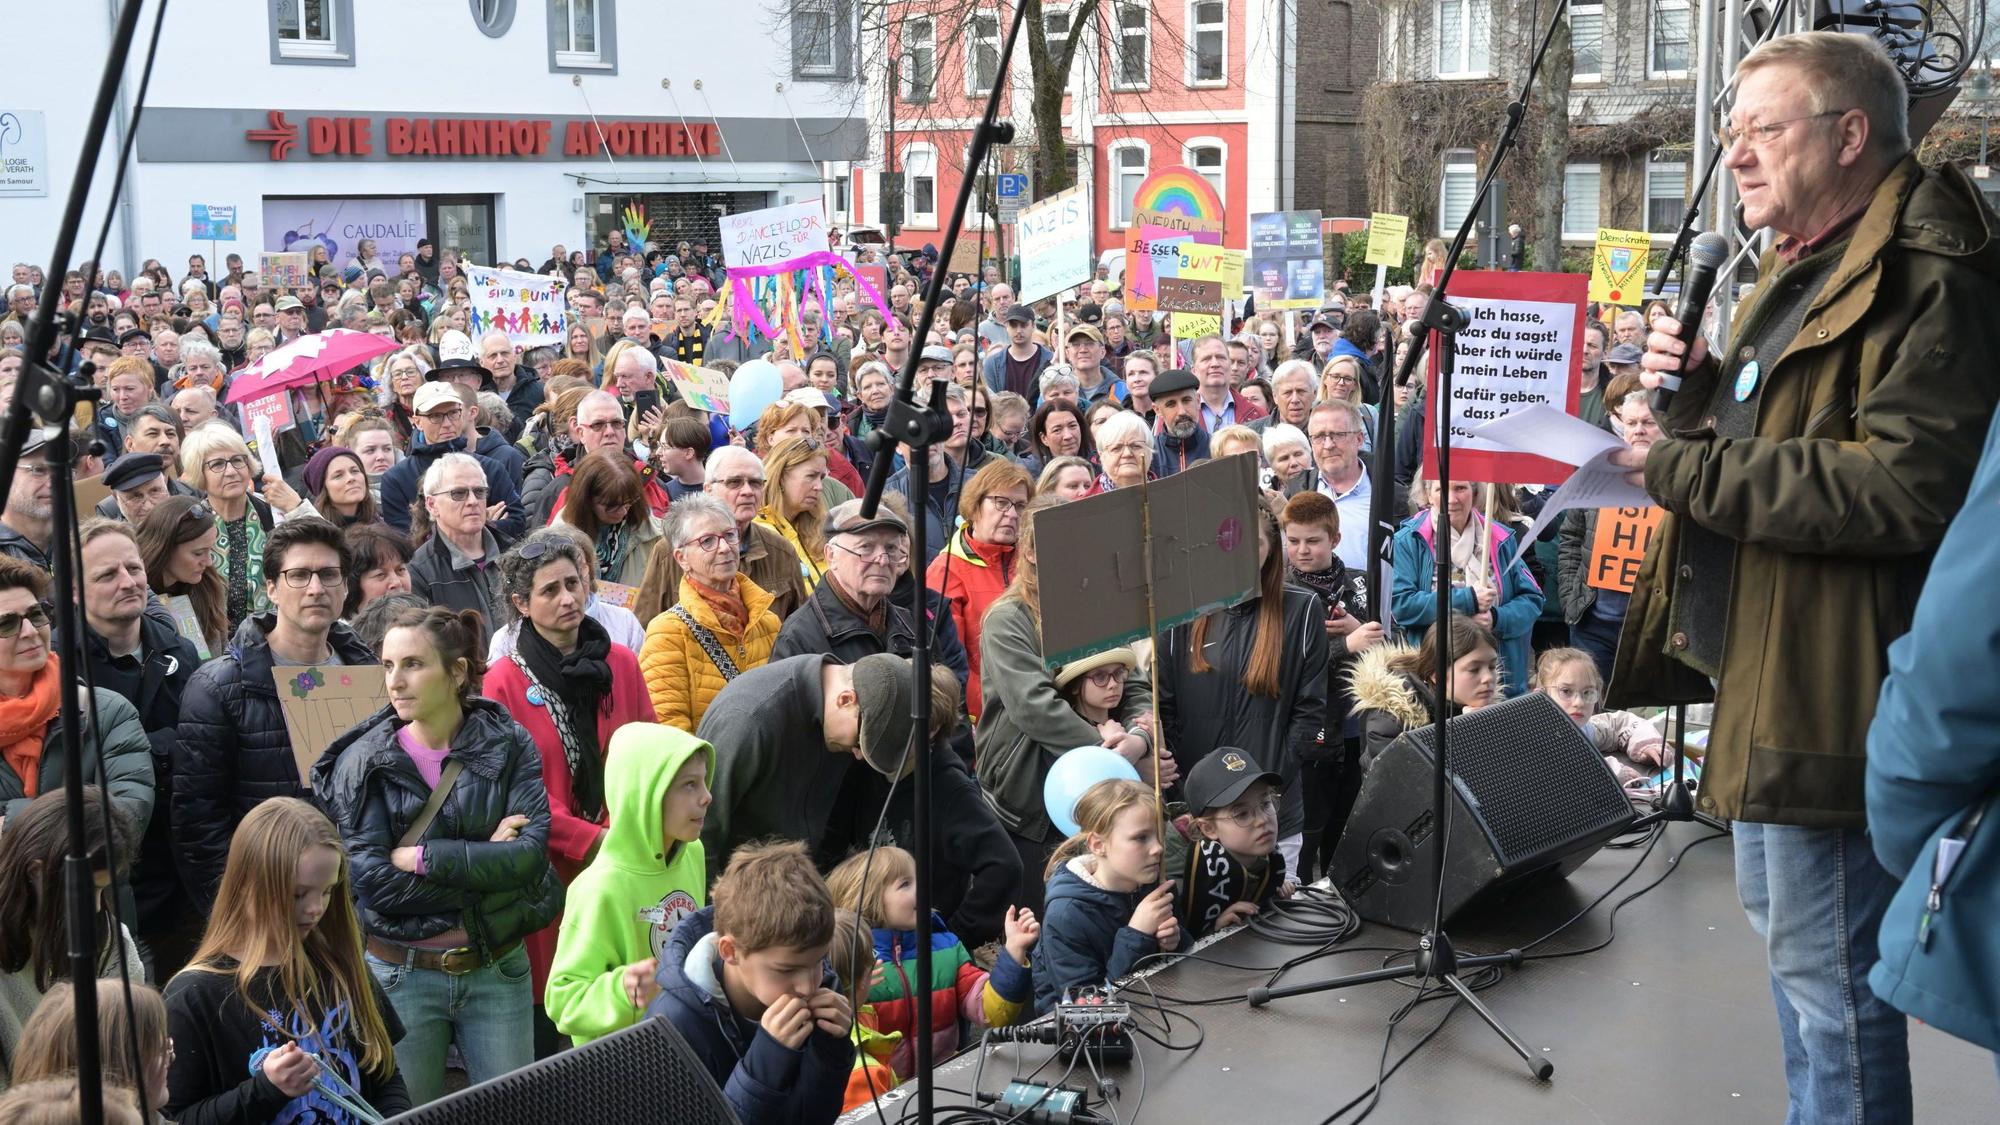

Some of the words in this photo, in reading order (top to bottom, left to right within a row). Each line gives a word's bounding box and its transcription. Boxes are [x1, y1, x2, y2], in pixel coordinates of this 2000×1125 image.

[307, 117, 372, 155] DIE
[386, 117, 551, 156] BAHNHOF
[563, 120, 720, 156] APOTHEKE
[1002, 177, 1015, 194] P
[736, 215, 822, 244] DANCEFLOOR
[1600, 231, 1650, 245] Demokraten
[741, 241, 792, 266] NAZIS
[1130, 239, 1180, 256] BESSER
[1180, 254, 1224, 272] BUNT
[1474, 307, 1496, 321] Ich
[1500, 308, 1545, 324] hasse,
[1491, 327, 1511, 340] du
[1515, 330, 1558, 343] sagst!
[1453, 343, 1486, 356] Aber
[1490, 346, 1511, 359] ich
[1516, 348, 1563, 361] würde
[1460, 364, 1498, 377] mein
[1502, 365, 1548, 379] Leben
[1453, 387, 1496, 401] dafür
[1500, 391, 1550, 404] geben,
[266, 403, 282, 415] die
[1463, 406, 1495, 420] dass
